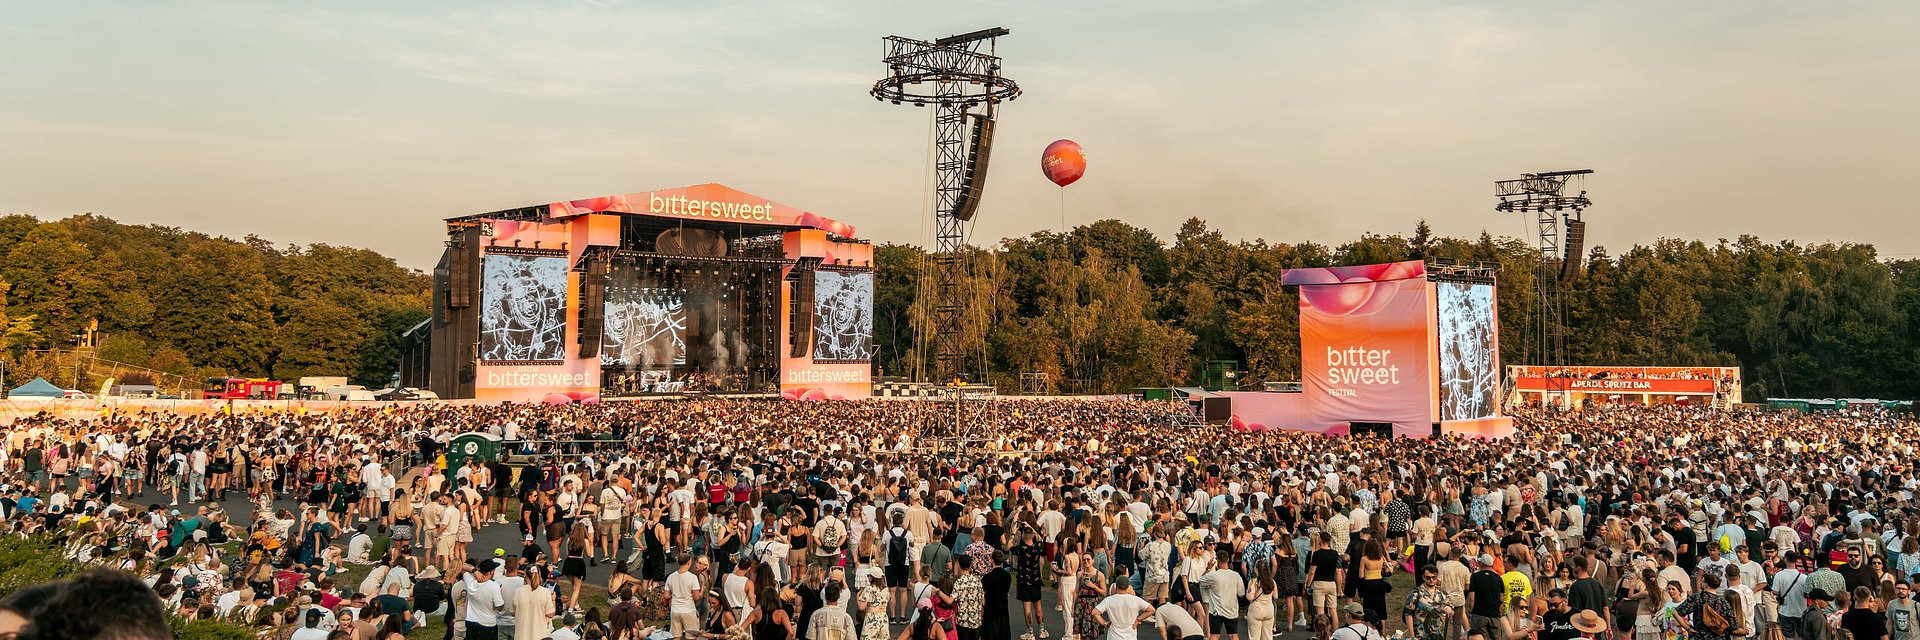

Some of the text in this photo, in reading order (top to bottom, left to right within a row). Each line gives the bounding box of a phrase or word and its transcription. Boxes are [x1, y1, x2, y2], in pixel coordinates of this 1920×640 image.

[649, 192, 773, 222] bittersweet
[1327, 345, 1391, 367] bitter
[488, 369, 592, 387] bittersweet
[788, 367, 864, 383] bittersweet
[1328, 363, 1400, 385] sweet
[1328, 388, 1358, 398] FESTIVAL
[1571, 380, 1603, 389] APEROL
[1633, 381, 1652, 389] BAR
[1550, 620, 1575, 633] Fender
